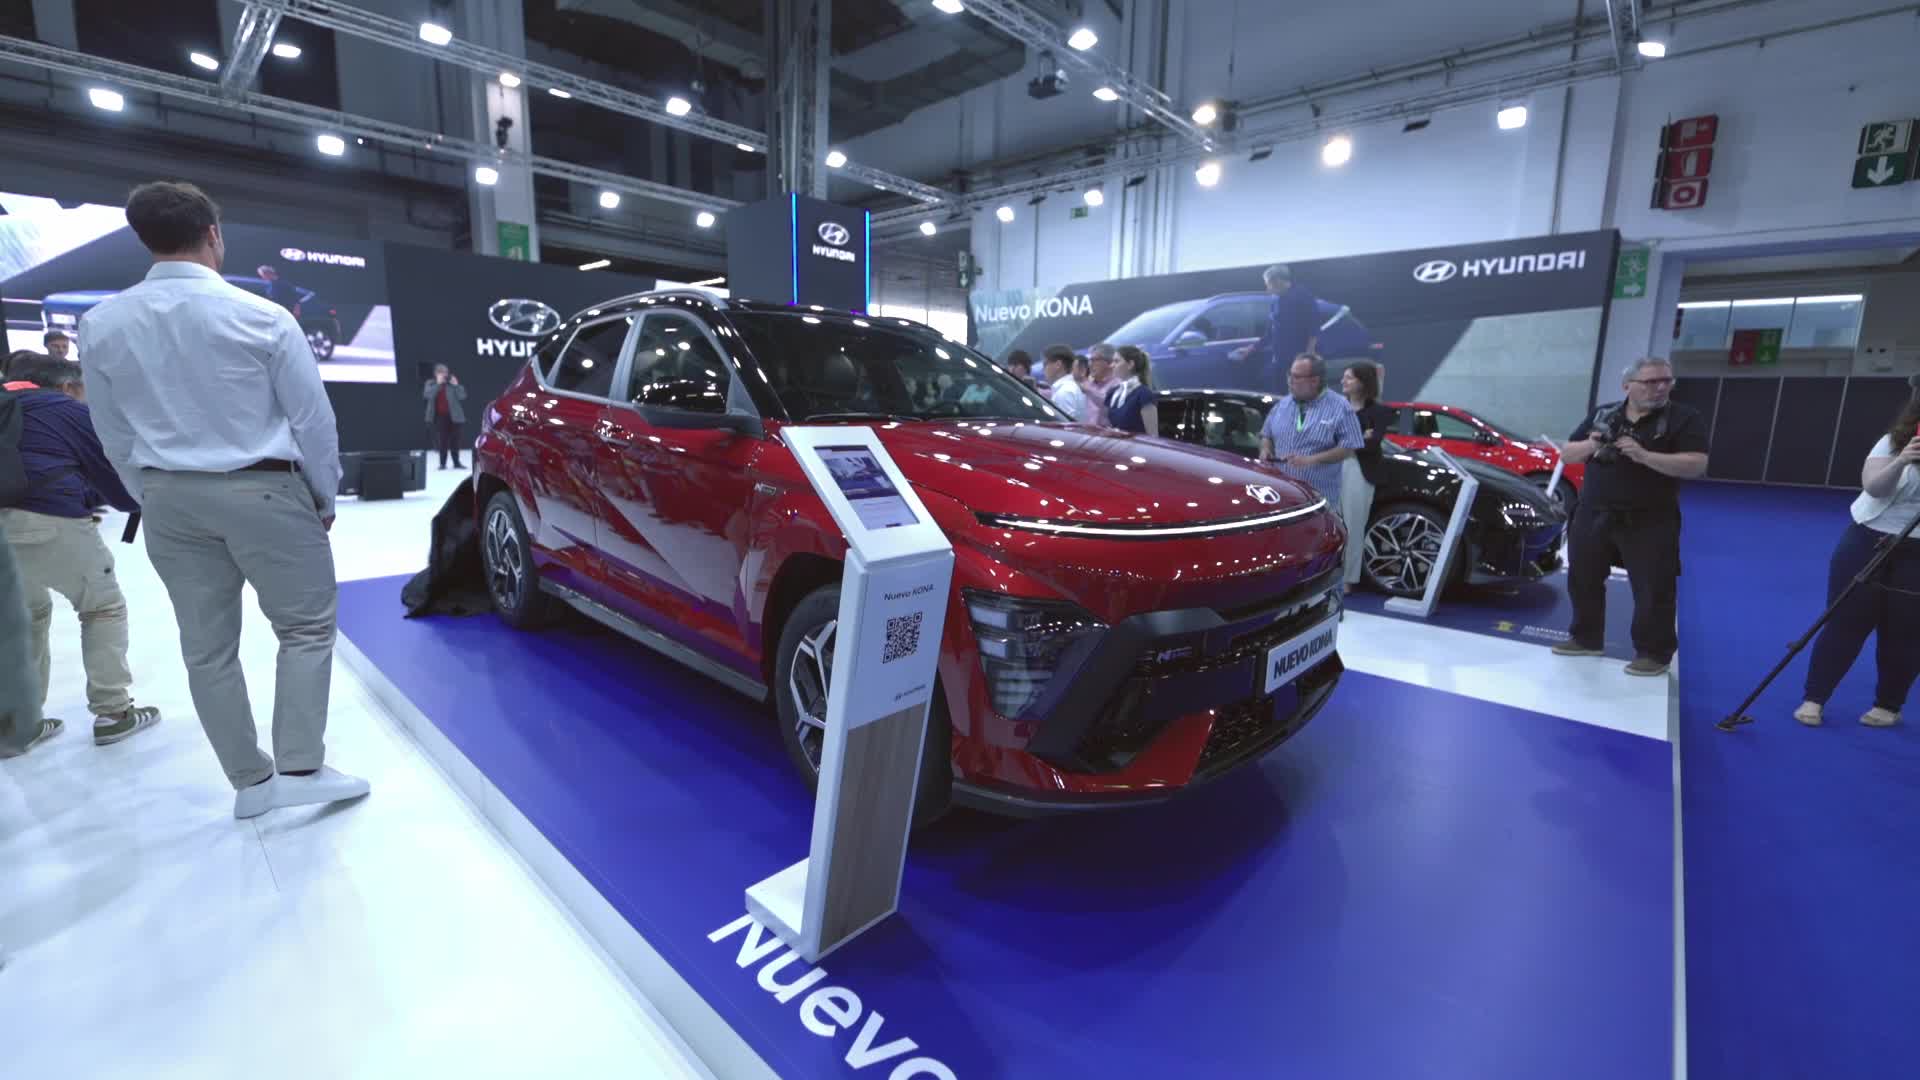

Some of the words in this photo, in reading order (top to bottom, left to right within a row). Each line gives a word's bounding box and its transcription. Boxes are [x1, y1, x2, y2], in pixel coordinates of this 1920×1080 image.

[307, 251, 365, 267] HYUNDAI
[812, 244, 855, 262] HYUNDAI
[1462, 250, 1586, 277] HYUNDAI
[975, 304, 1031, 322] Nuevo
[1035, 294, 1094, 318] KONA
[884, 591, 911, 601] Nuevo
[1273, 643, 1309, 680] NUEVO
[1309, 627, 1333, 659] KONA
